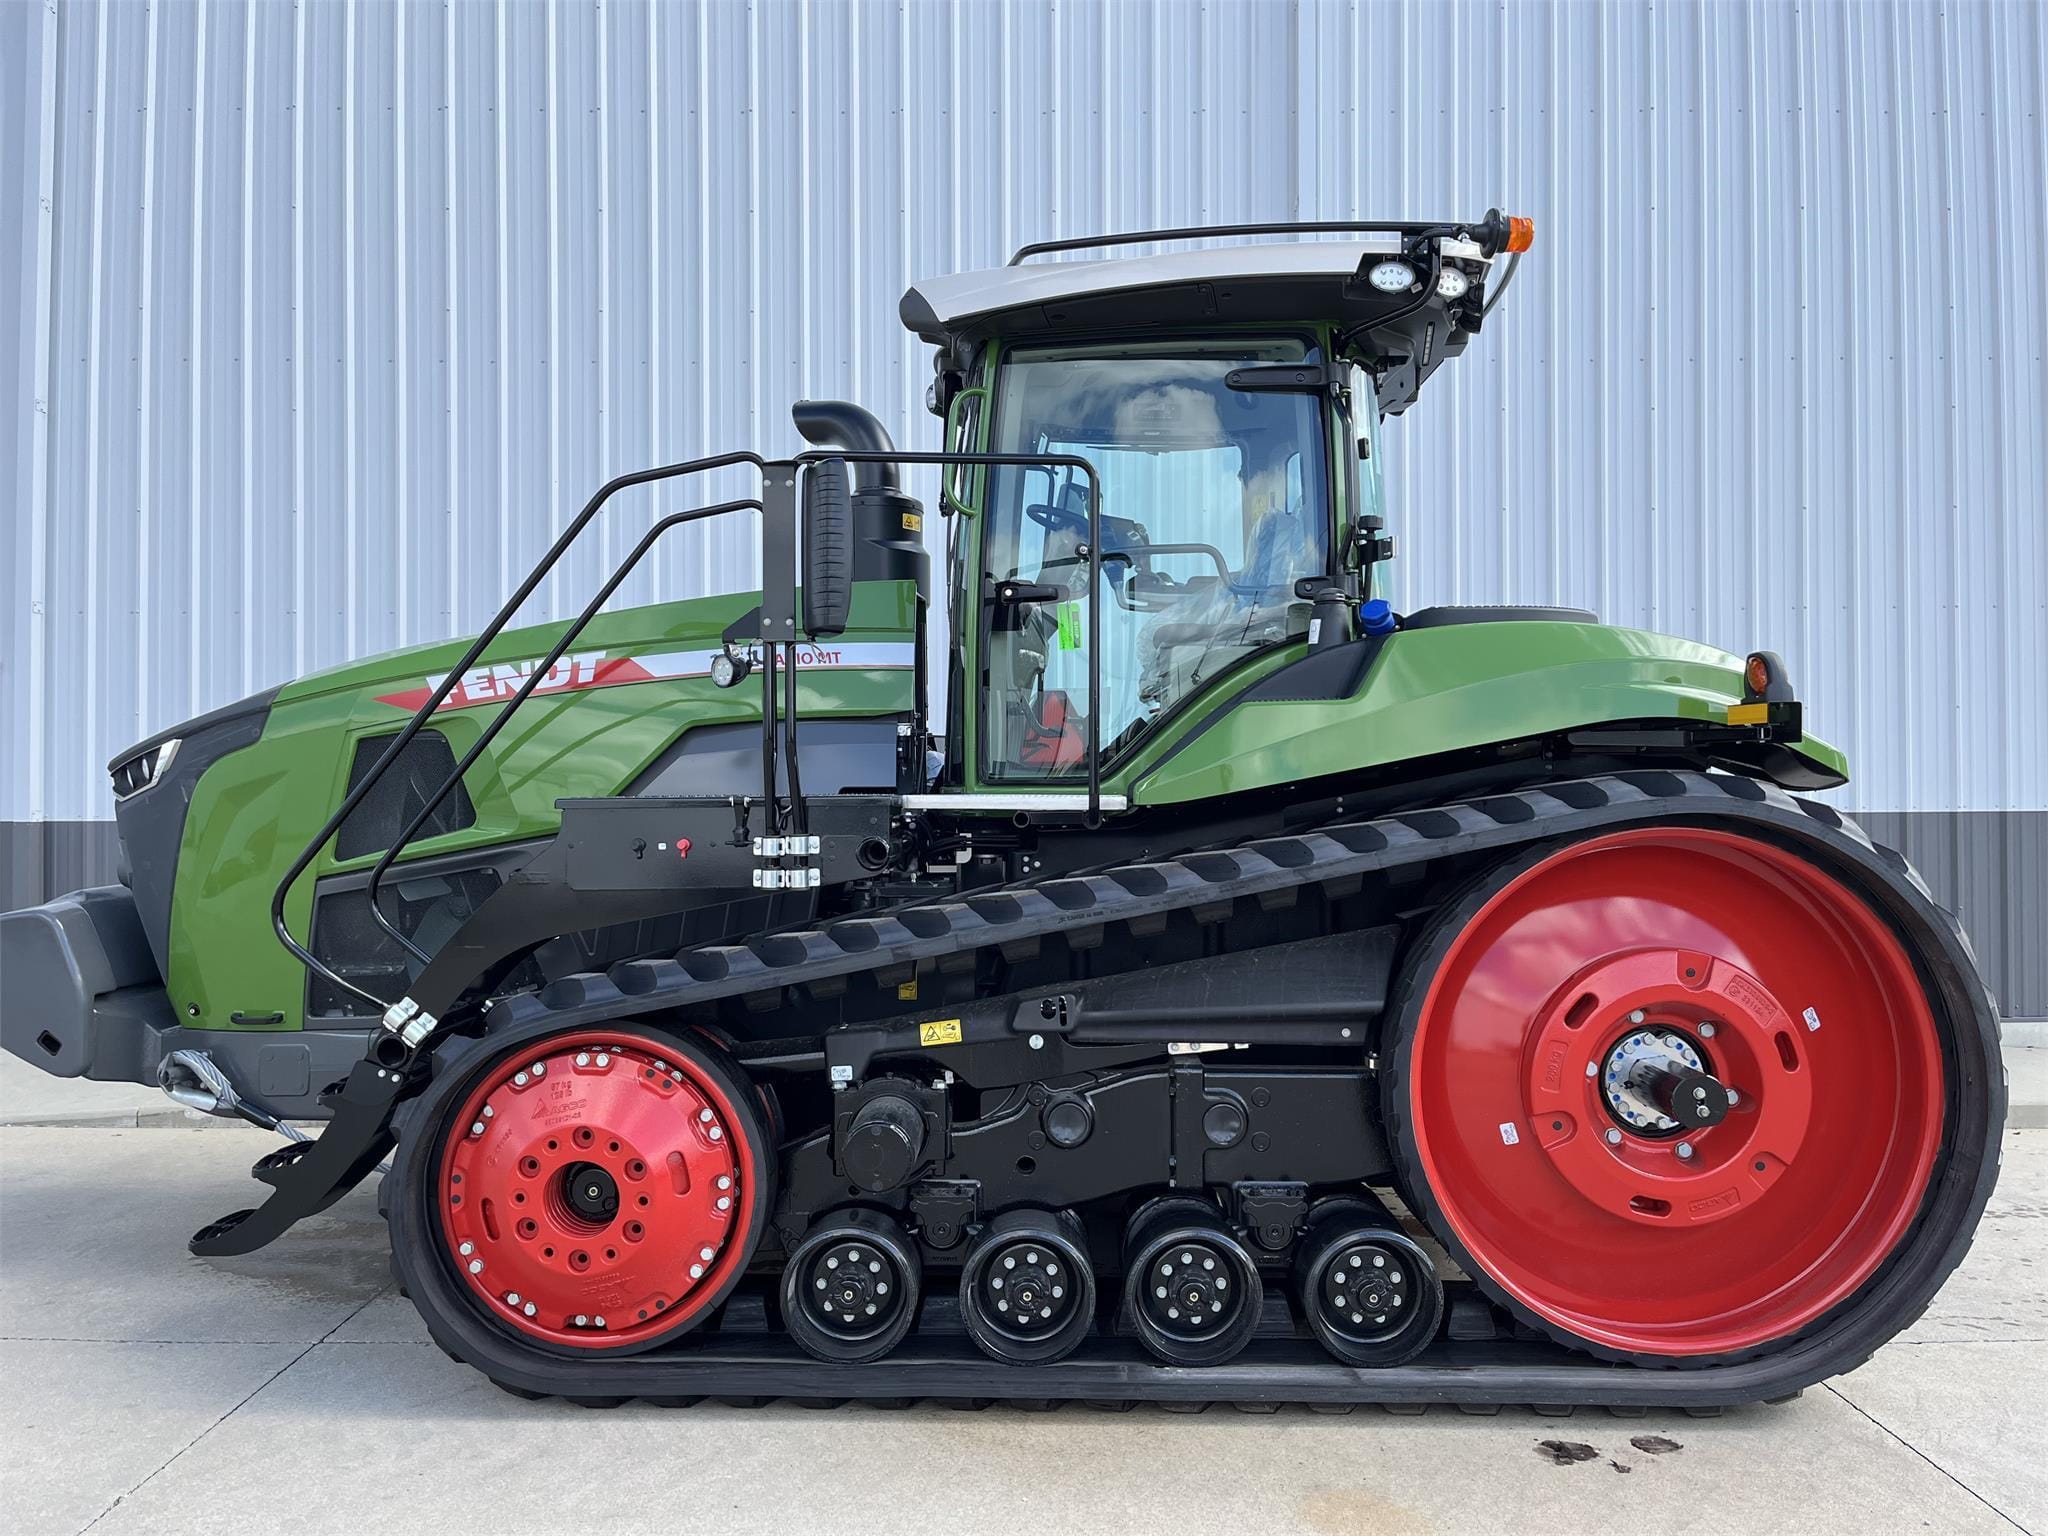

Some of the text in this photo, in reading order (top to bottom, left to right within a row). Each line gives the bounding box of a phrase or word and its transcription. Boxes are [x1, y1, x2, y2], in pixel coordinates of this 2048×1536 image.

[774, 651, 842, 665] AIO MT
[426, 651, 607, 706] FENDT
